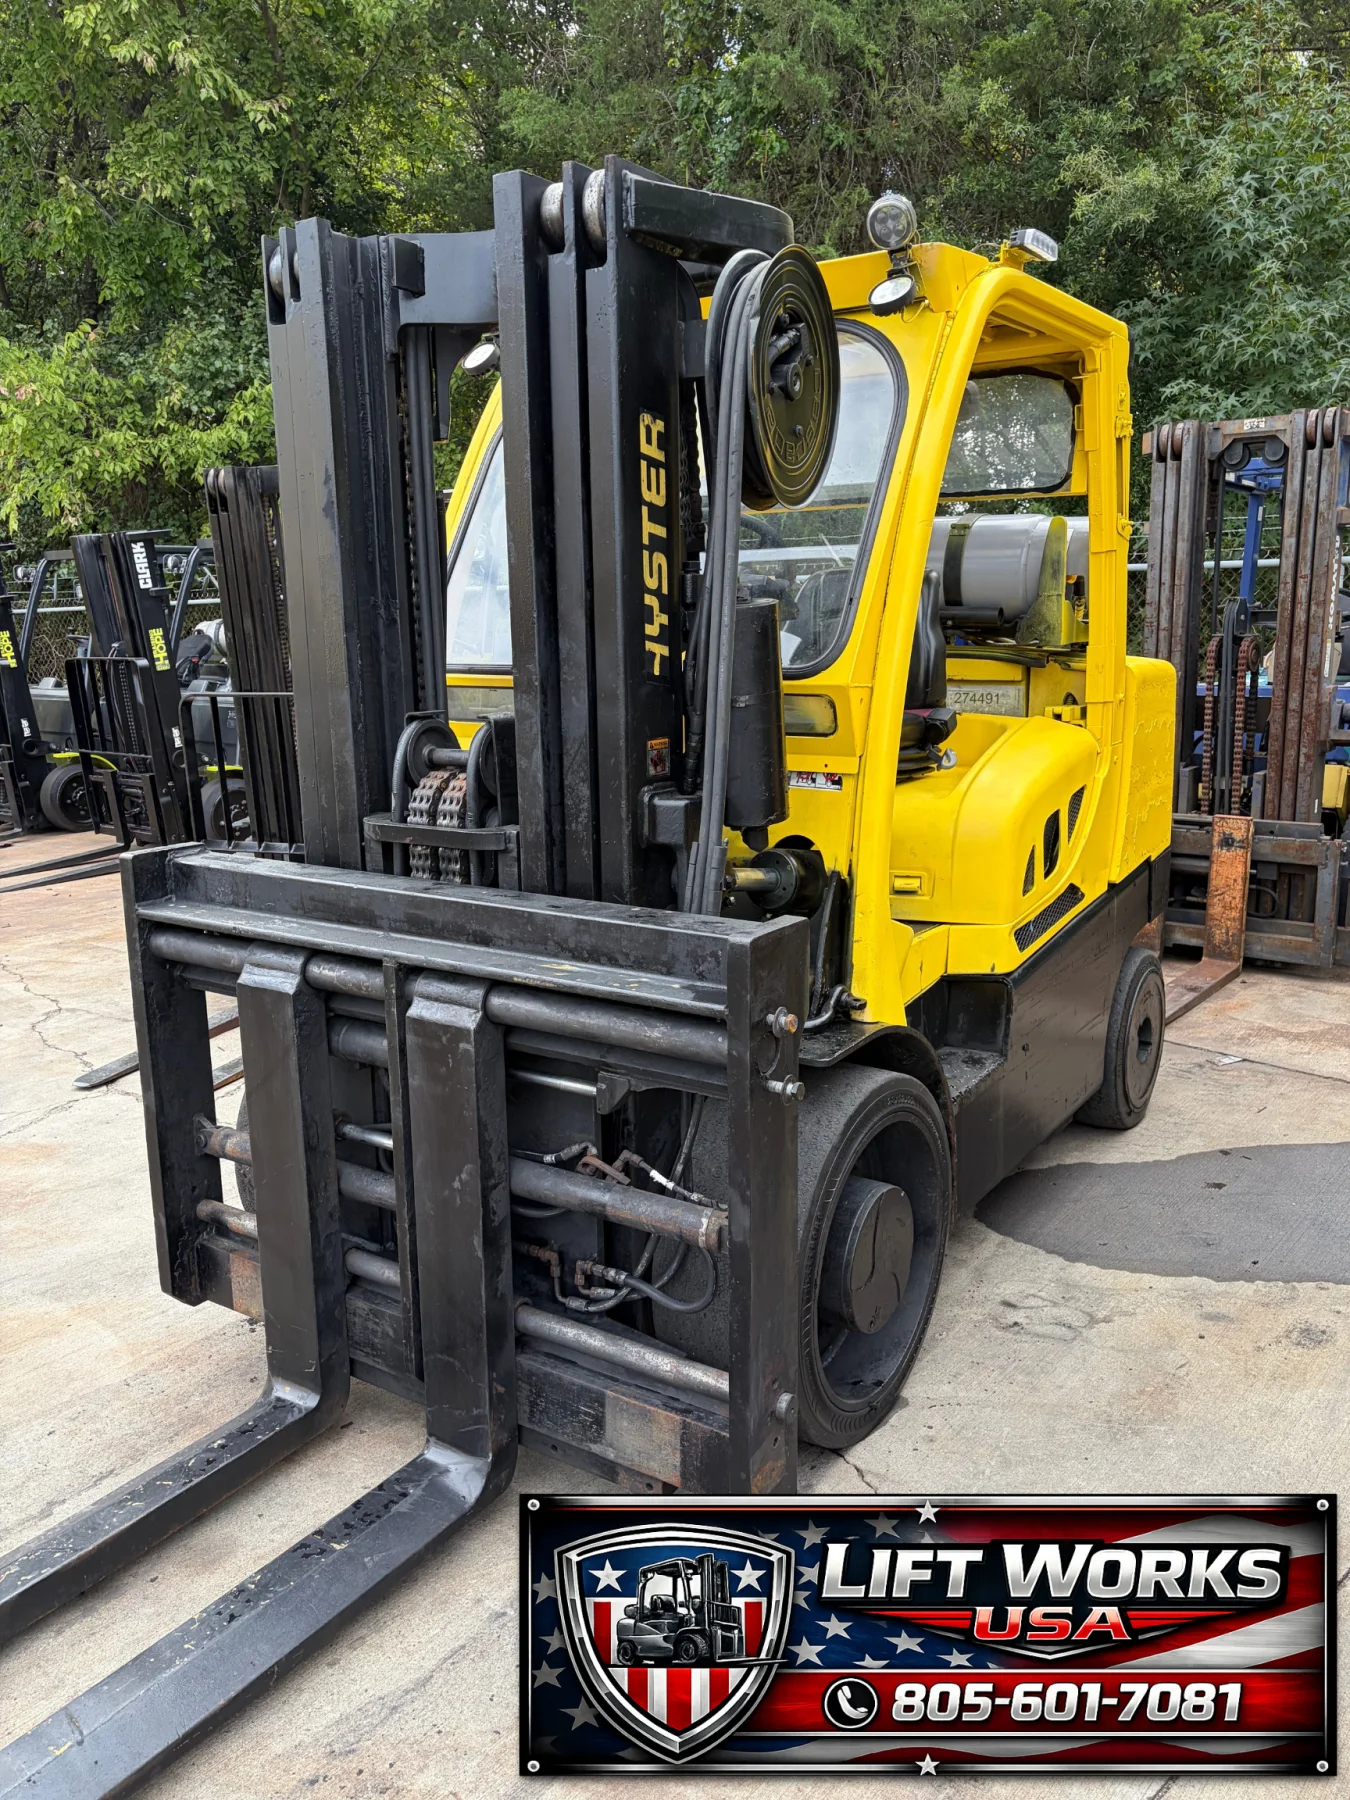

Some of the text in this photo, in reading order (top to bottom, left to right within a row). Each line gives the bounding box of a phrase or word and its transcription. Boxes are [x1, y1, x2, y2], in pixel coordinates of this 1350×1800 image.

[639, 412, 670, 676] HYSTER
[131, 541, 153, 589] CLARK
[1, 630, 17, 666] HOPE
[152, 627, 170, 666] HOPE
[954, 692, 1001, 705] 274491
